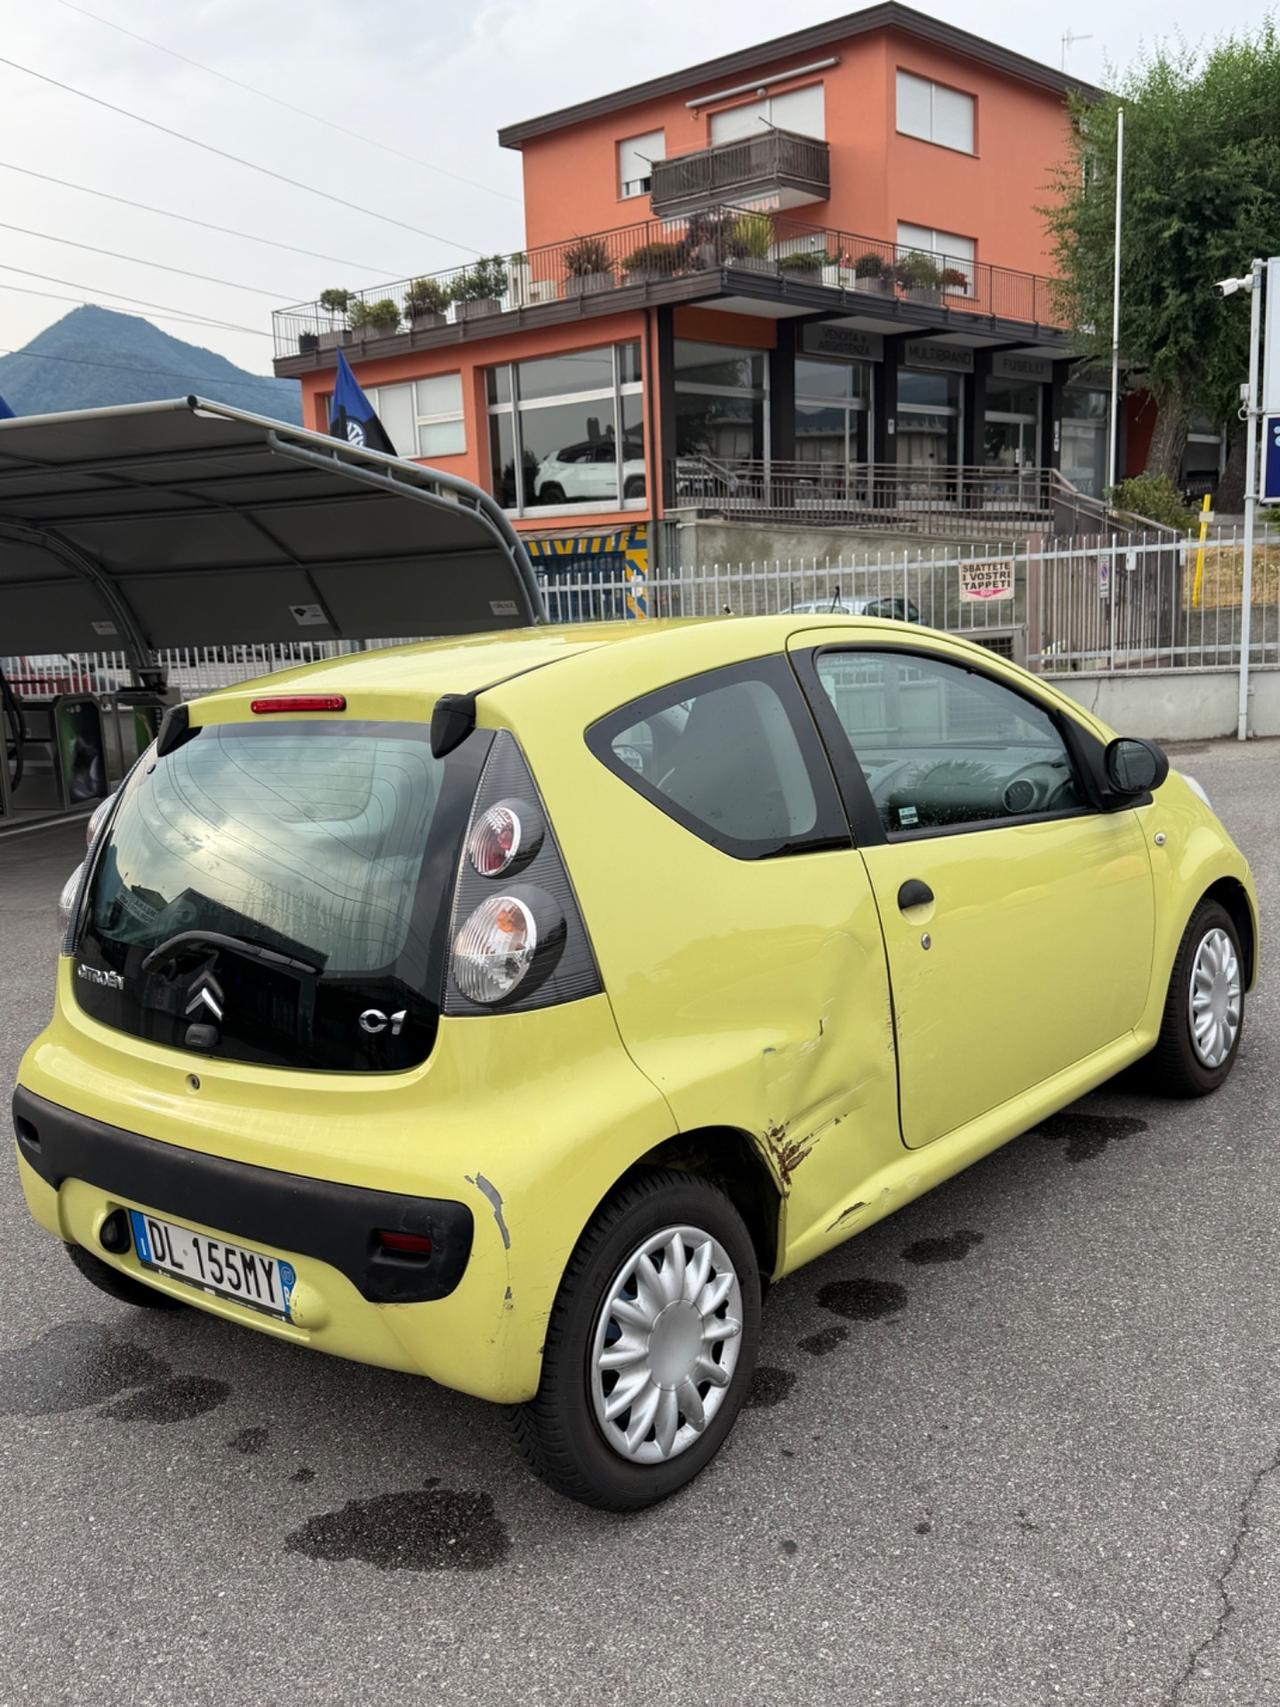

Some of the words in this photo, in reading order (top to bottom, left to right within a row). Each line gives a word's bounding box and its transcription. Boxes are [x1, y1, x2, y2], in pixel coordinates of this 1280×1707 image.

[962, 562, 1011, 572] SBATTETE
[970, 571, 1011, 581] VOSTRI
[962, 580, 1011, 590] TAPPETI
[359, 1009, 407, 1035] C1
[148, 1219, 184, 1270] DL
[192, 1237, 276, 1303] 155MY
